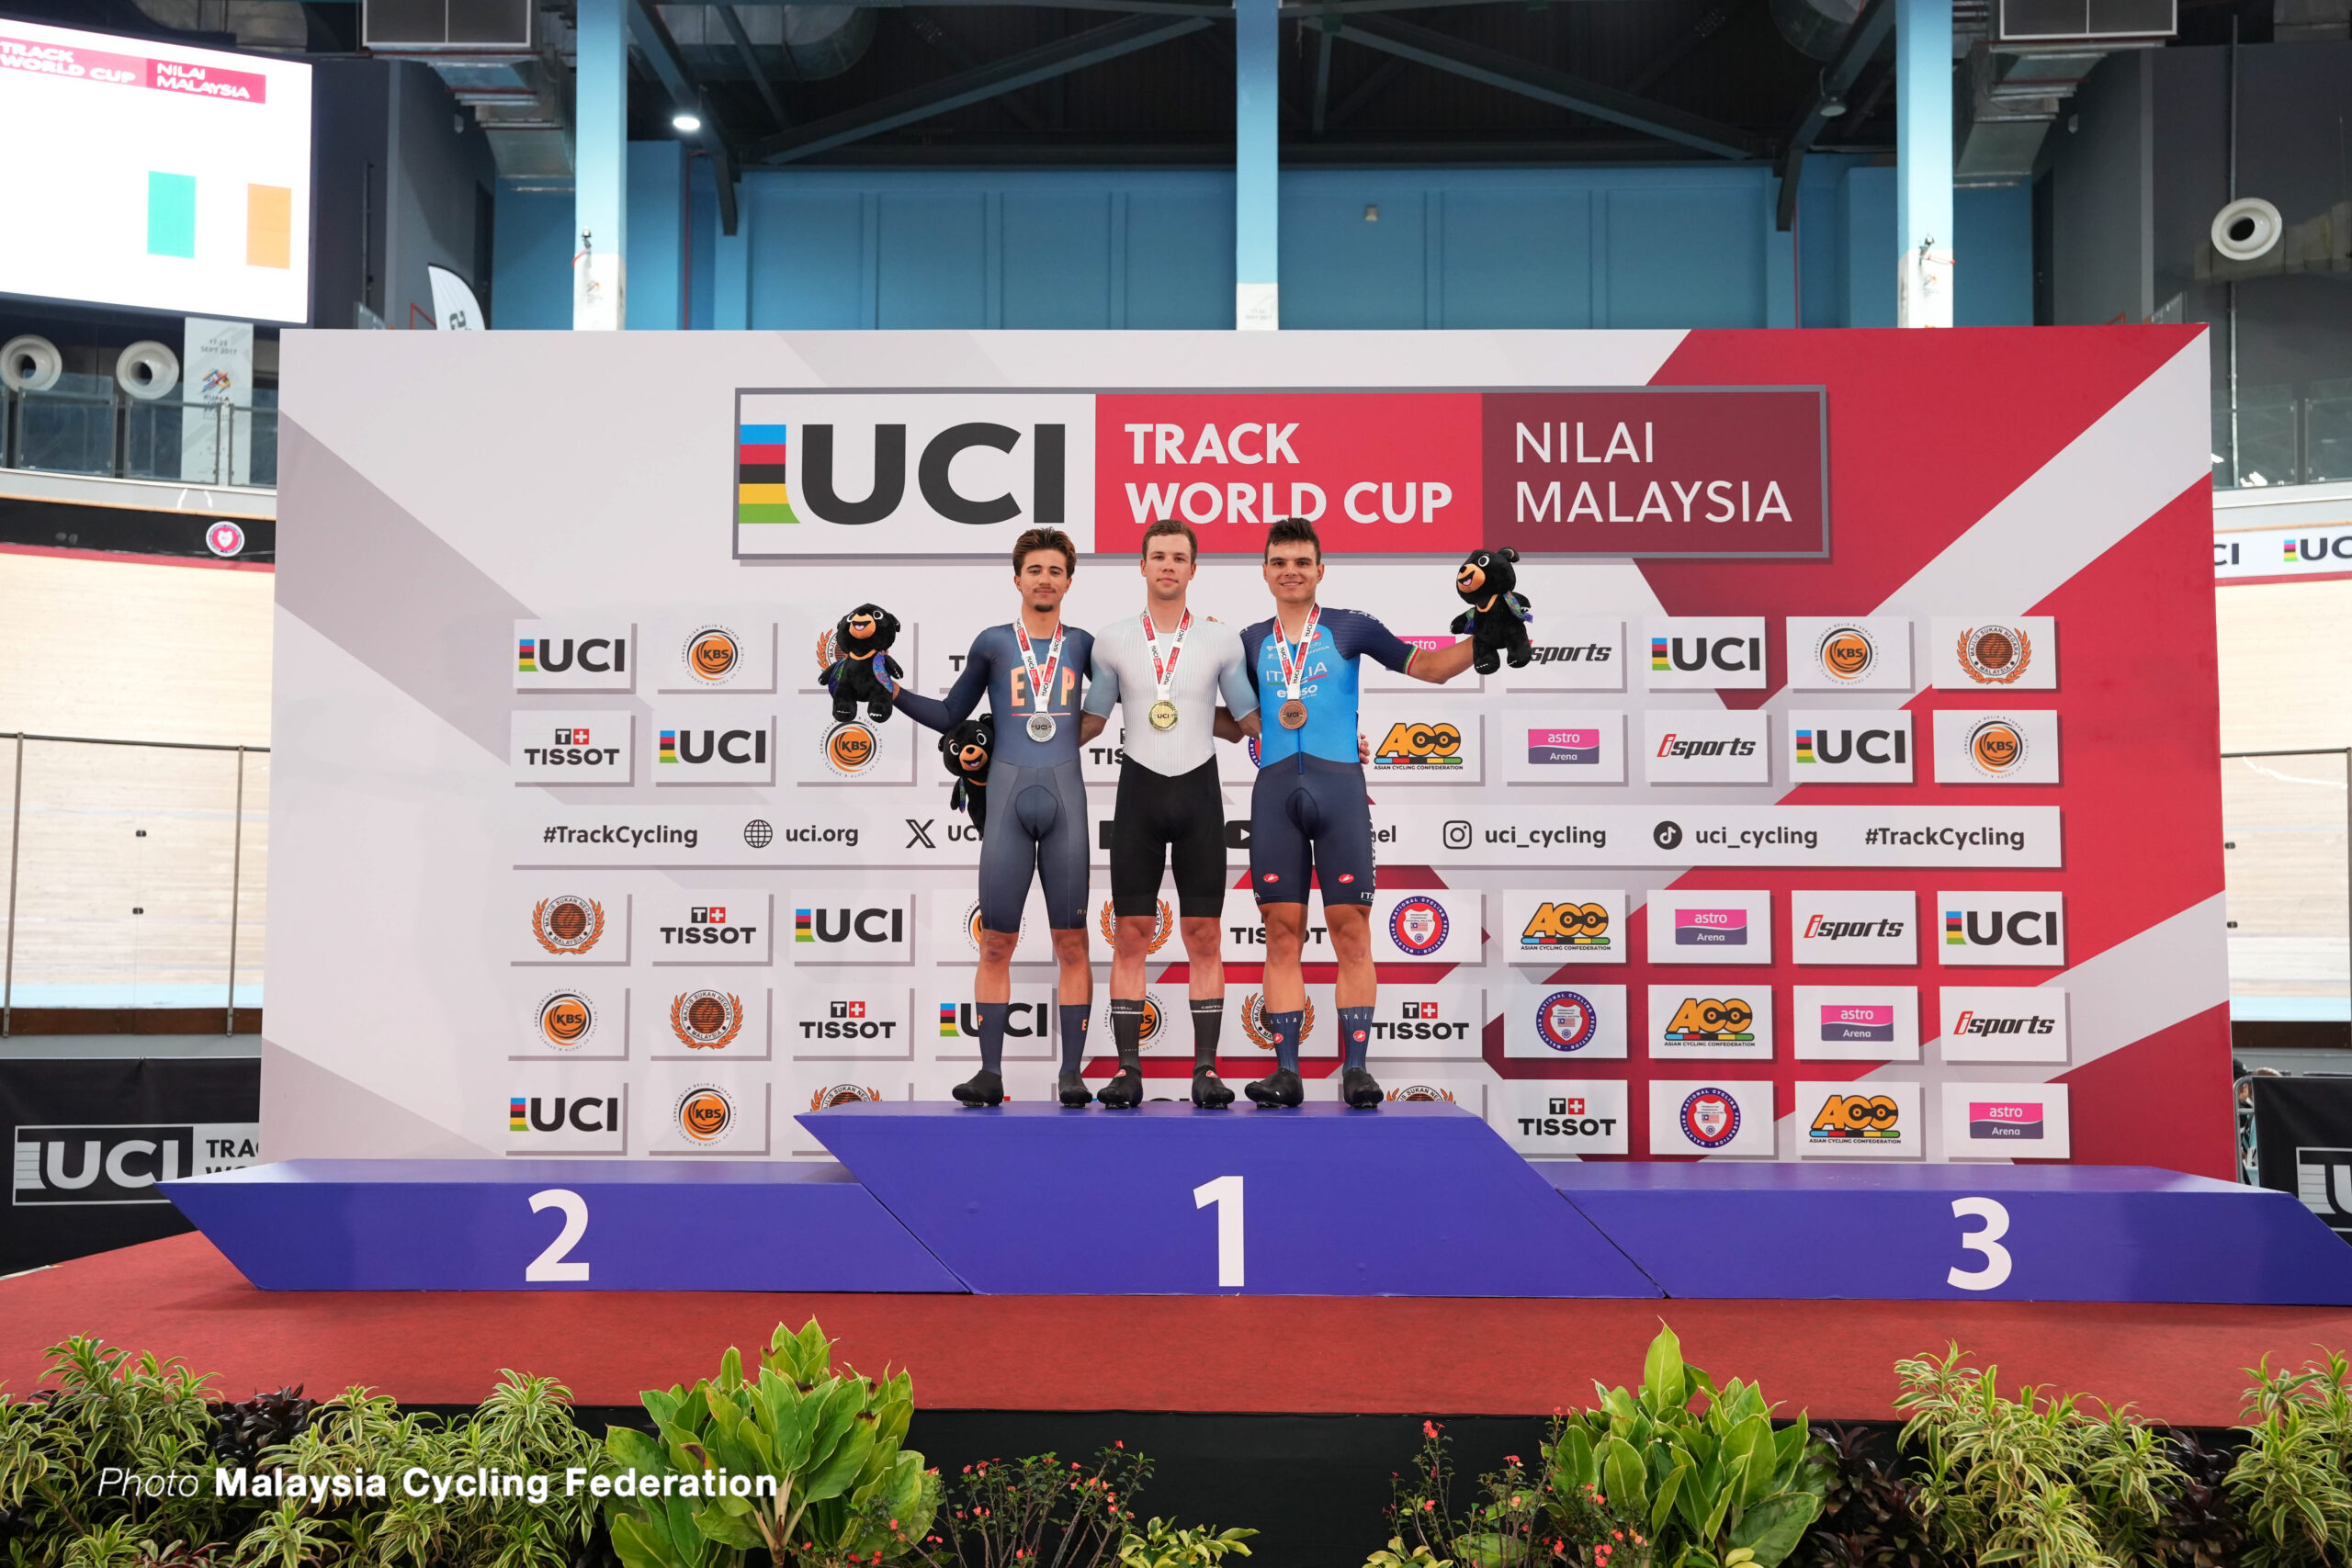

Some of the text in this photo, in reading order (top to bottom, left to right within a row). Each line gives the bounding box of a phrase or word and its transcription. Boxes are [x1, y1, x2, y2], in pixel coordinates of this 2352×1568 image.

[1, 41, 74, 62] TRACK
[0, 53, 136, 85] WORLD CUP
[157, 62, 206, 81] NILAI
[157, 76, 250, 99] MALAYSIA
[1124, 423, 1301, 465] TRACK
[1516, 422, 1654, 463] NILAI
[801, 422, 1066, 525] UCI
[1124, 480, 1453, 525] WORLD CUP
[1516, 480, 1793, 523] MALAYSIA
[2300, 536, 2352, 561] UC
[1529, 639, 1611, 665] sports
[1672, 637, 1760, 671] UCI
[1837, 648, 1863, 660] KBS
[1971, 634, 1980, 657] MAJLIS
[2004, 630, 2018, 656] NEGARA
[538, 638, 625, 672] UCI
[704, 649, 729, 661] KBS
[1979, 664, 2010, 675] MALAYSIA
[680, 729, 766, 764] UCI
[842, 739, 868, 752] KBS
[1547, 732, 1580, 743] astro
[1816, 729, 1905, 764] UCI
[1986, 740, 2014, 753] KBS
[524, 749, 620, 765] TISSOT
[1549, 752, 1577, 761] Arena
[543, 825, 698, 848] #TrackCycling
[786, 825, 858, 846] uci.org
[1485, 826, 1607, 848] uci_cycling
[1695, 826, 1818, 849] uci_cycling
[1865, 827, 2025, 851] #TrackCycling
[545, 904, 556, 927] MAJLIS
[580, 901, 592, 926] NEGARA
[1392, 897, 1418, 919] NATIONAL
[1421, 897, 1445, 918] CYCLING
[1694, 912, 1727, 924] astro
[660, 927, 756, 944] TISSOT
[816, 908, 902, 943] UCI
[1967, 910, 2057, 946] UCI
[553, 935, 583, 945] MALAYSIA
[1696, 933, 1724, 942] Arena
[684, 991, 730, 1021] MAJLIS SUKAN NEGARA
[1539, 993, 1566, 1015] NATIONAL
[1568, 993, 1593, 1013] CYCLING
[1840, 1009, 1874, 1021] astro
[557, 1013, 582, 1026] KBS
[799, 1021, 897, 1039] TISSOT
[692, 1030, 722, 1039] MALAYSIA
[1372, 1022, 1469, 1040] TISSOT
[1843, 1029, 1871, 1038] Arena
[834, 1086, 856, 1094] SUKAN
[857, 1090, 867, 1101] NEG
[1682, 1089, 1709, 1111] NATIONAL
[1713, 1089, 1736, 1110] CYCLING
[530, 1097, 618, 1132] UCI
[695, 1108, 722, 1121] KBS
[1989, 1106, 2023, 1118] astro
[1518, 1118, 1617, 1136] TISSOT
[1992, 1126, 2020, 1135] Arena
[206, 1139, 259, 1157] TRA
[47, 1140, 179, 1190] UCI
[526, 1188, 590, 1282] 2
[1193, 1175, 1244, 1287] 1
[1947, 1196, 2012, 1291] 3
